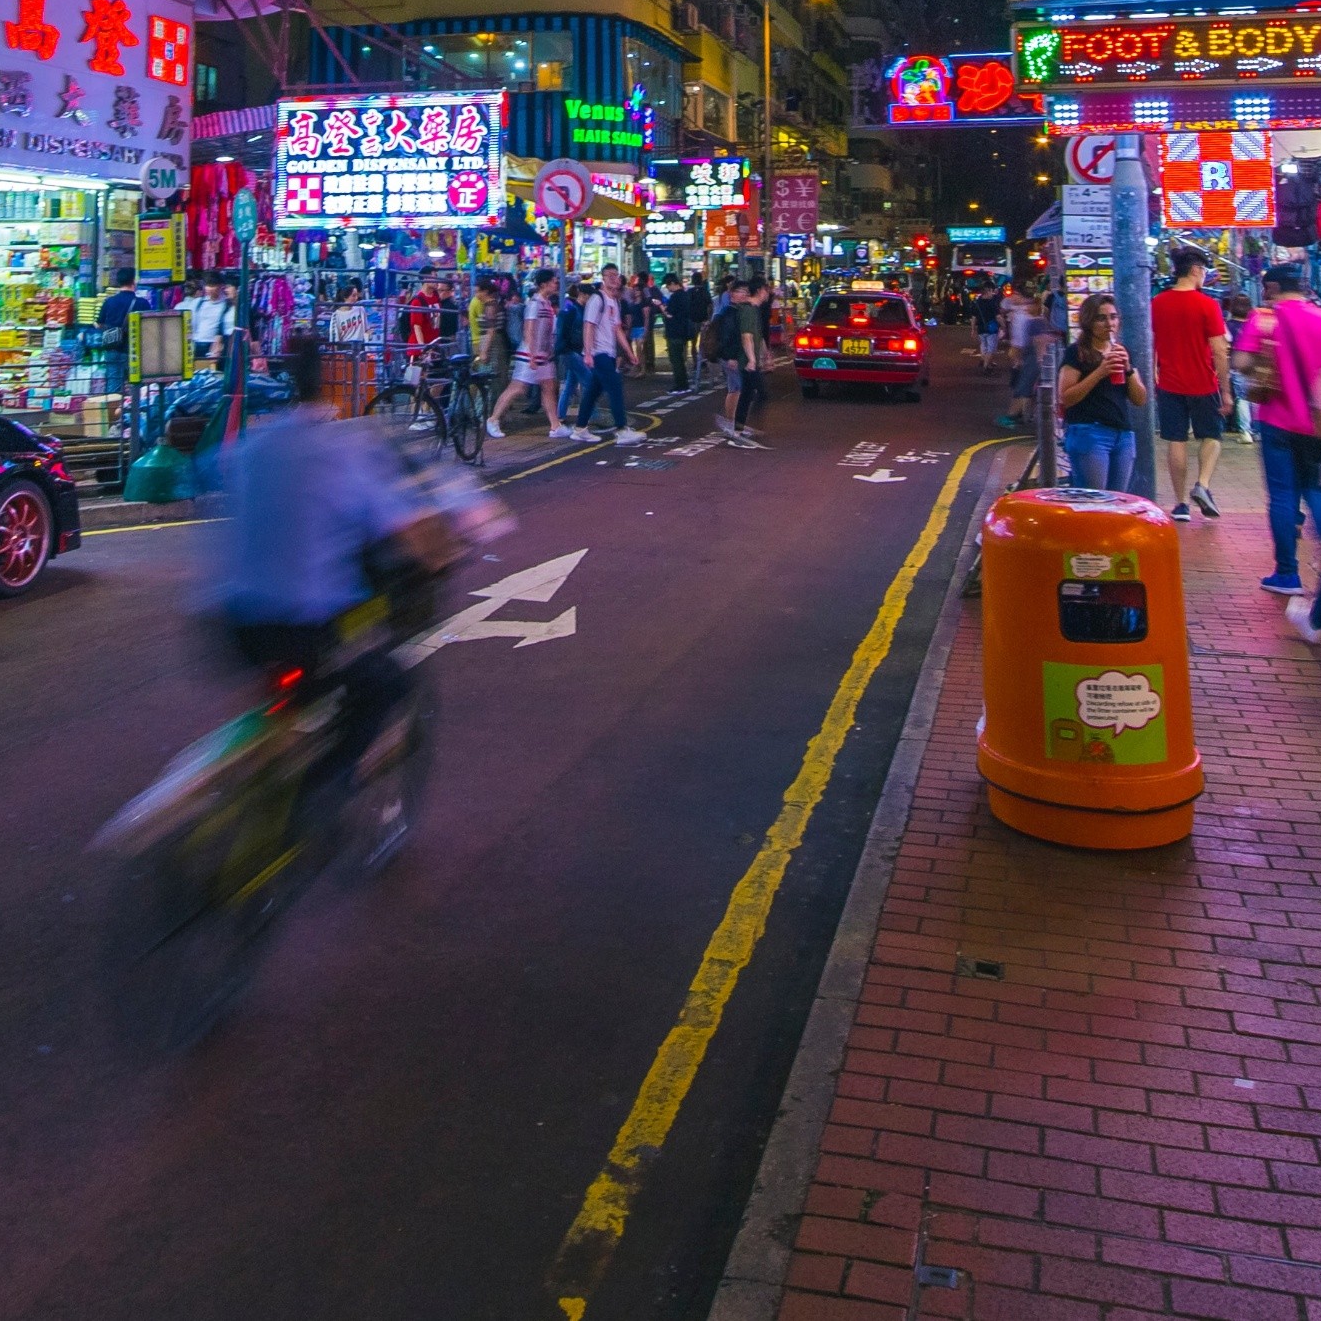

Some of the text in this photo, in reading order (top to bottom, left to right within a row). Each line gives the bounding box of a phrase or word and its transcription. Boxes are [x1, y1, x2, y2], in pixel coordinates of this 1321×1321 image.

[1061, 26, 1171, 61] FOOT
[1174, 31, 1198, 58] &
[1208, 25, 1321, 56] BODY
[565, 99, 624, 122] Venus
[573, 128, 610, 144] HAIR
[24, 132, 146, 164] DISPENSARY
[286, 158, 349, 173] GOLDEN
[352, 157, 447, 172] DISPENSARY
[149, 168, 176, 189] 5M
